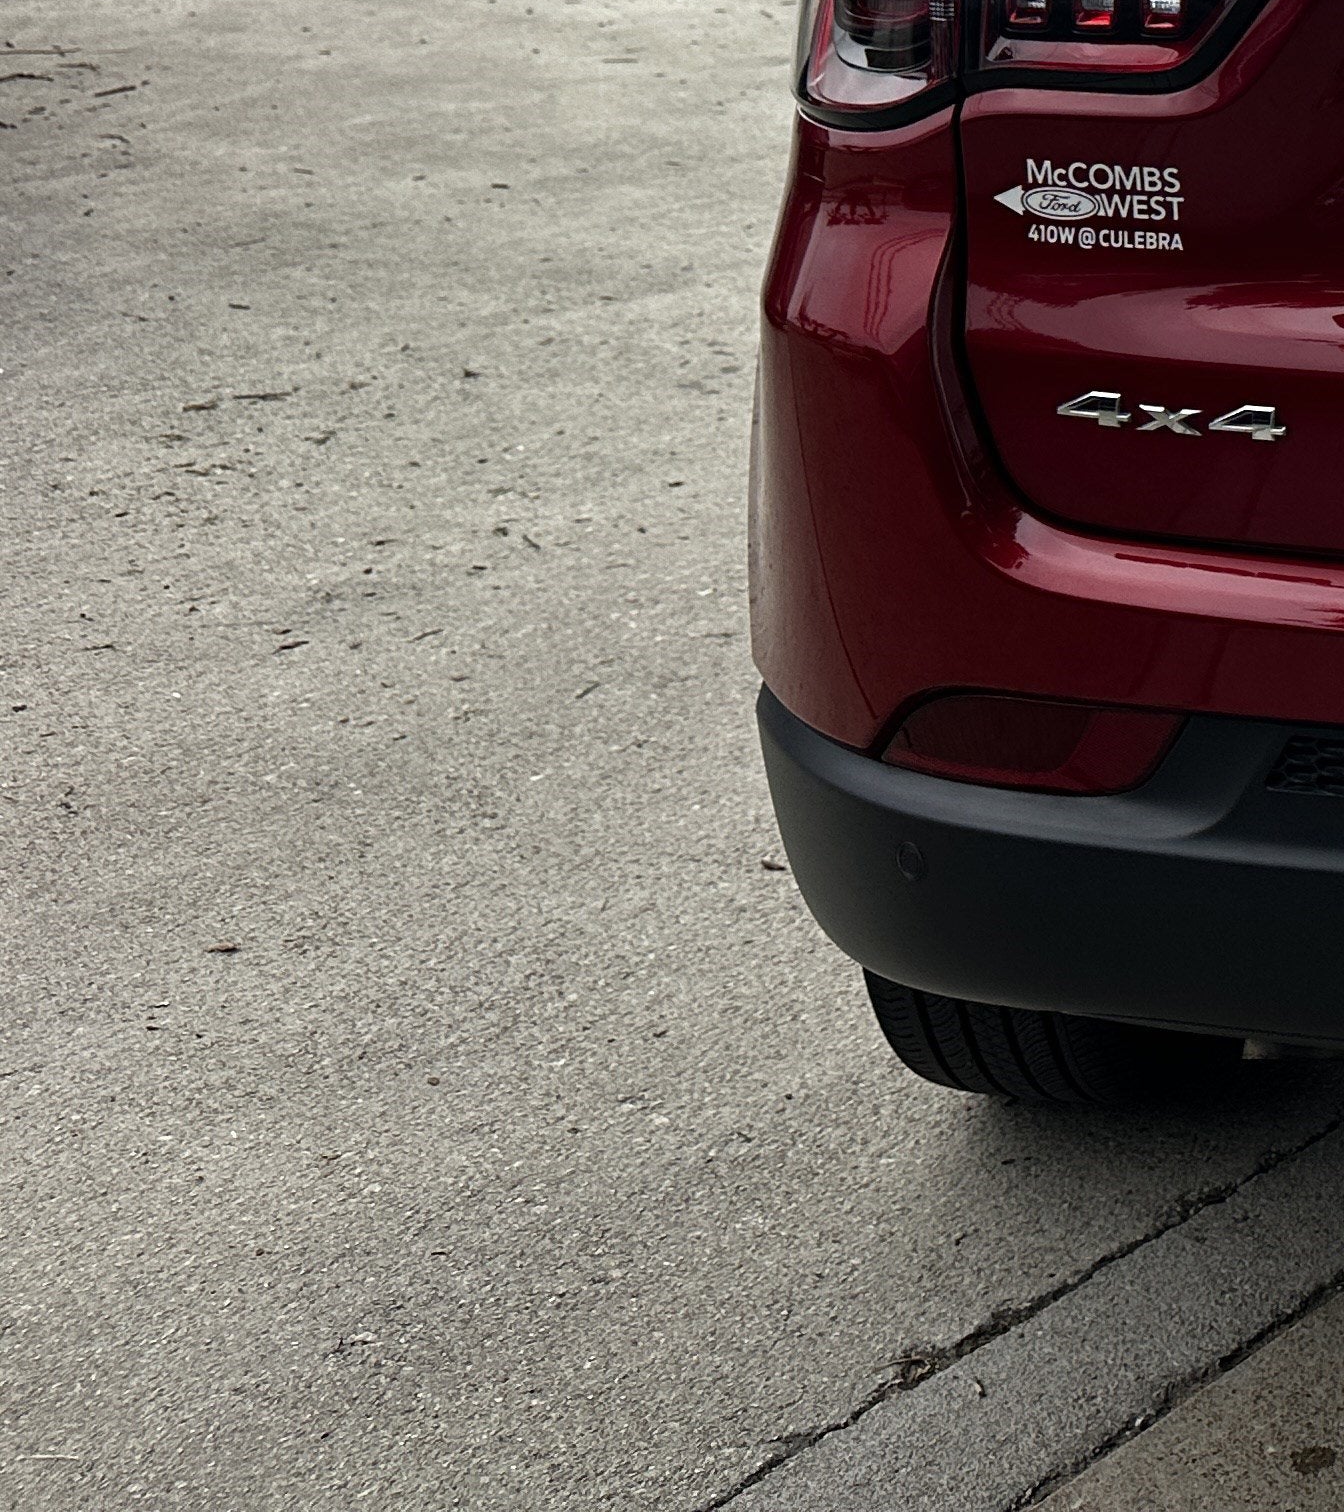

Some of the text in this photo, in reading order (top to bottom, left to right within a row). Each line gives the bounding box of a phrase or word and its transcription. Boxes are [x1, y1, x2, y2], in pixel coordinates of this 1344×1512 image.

[1026, 158, 1181, 193] McCOMBS
[1039, 193, 1082, 213] Ford
[1100, 193, 1185, 221] WEST
